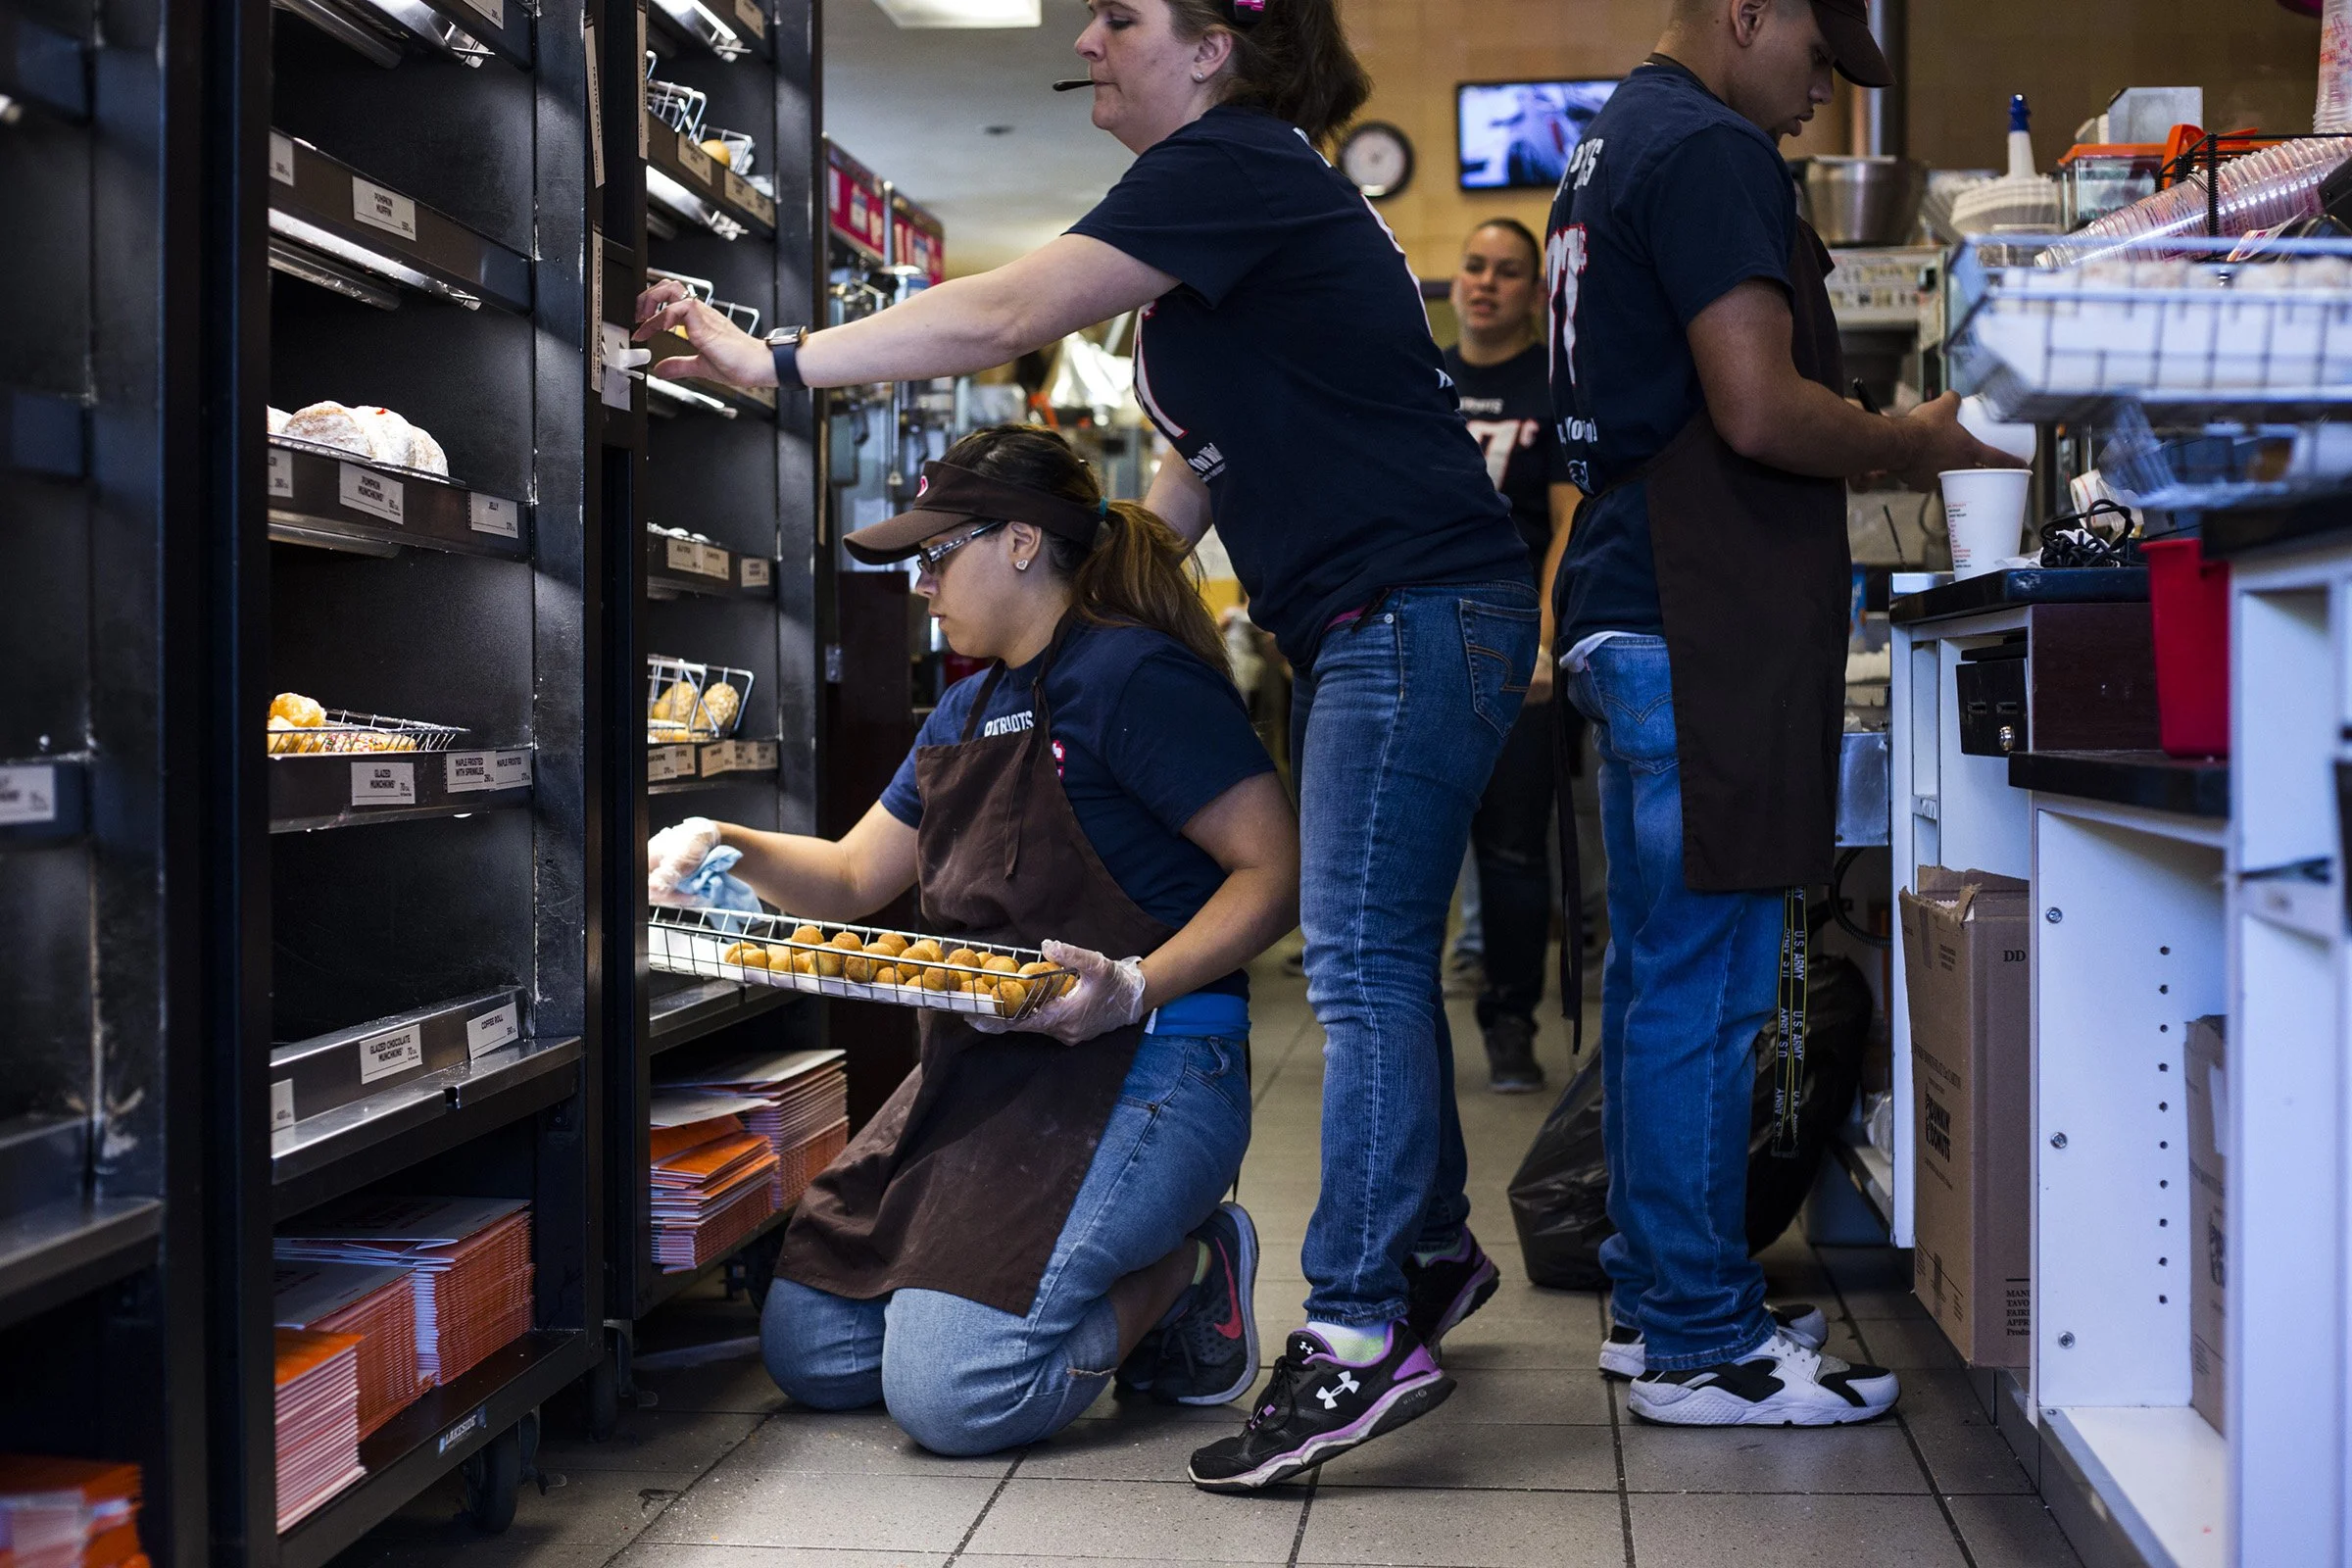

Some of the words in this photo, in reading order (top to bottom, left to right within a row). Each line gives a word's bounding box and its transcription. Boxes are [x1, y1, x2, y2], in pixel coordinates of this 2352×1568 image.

[373, 192, 393, 208] PUMPKIN
[375, 204, 392, 217] MUFFIN
[361, 475, 381, 491] PUMPKIN
[488, 502, 499, 511] JELLY
[455, 759, 466, 767] MAPLE
[466, 757, 484, 766] FROSTED
[507, 757, 522, 765] FROSTED
[373, 769, 392, 778] GLAZED
[465, 766, 485, 776] SPRINKLES
[1792, 930, 1805, 950] U.S.
[2003, 949, 2027, 962] DD
[1792, 953, 1805, 981] ARMY
[480, 1016, 495, 1030] COFFEE
[494, 1013, 504, 1025] ROLL
[1780, 1007, 1789, 1035] ARMY
[1792, 1009, 1804, 1030] U.S.
[369, 1041, 387, 1055] GLAZED
[386, 1034, 411, 1050] CHOCOLATE
[1778, 1038, 1788, 1058] U.S.
[1792, 1033, 1804, 1060] ARMY
[1775, 1088, 1786, 1115] ARMY
[445, 1414, 477, 1446] LAKESIDE
